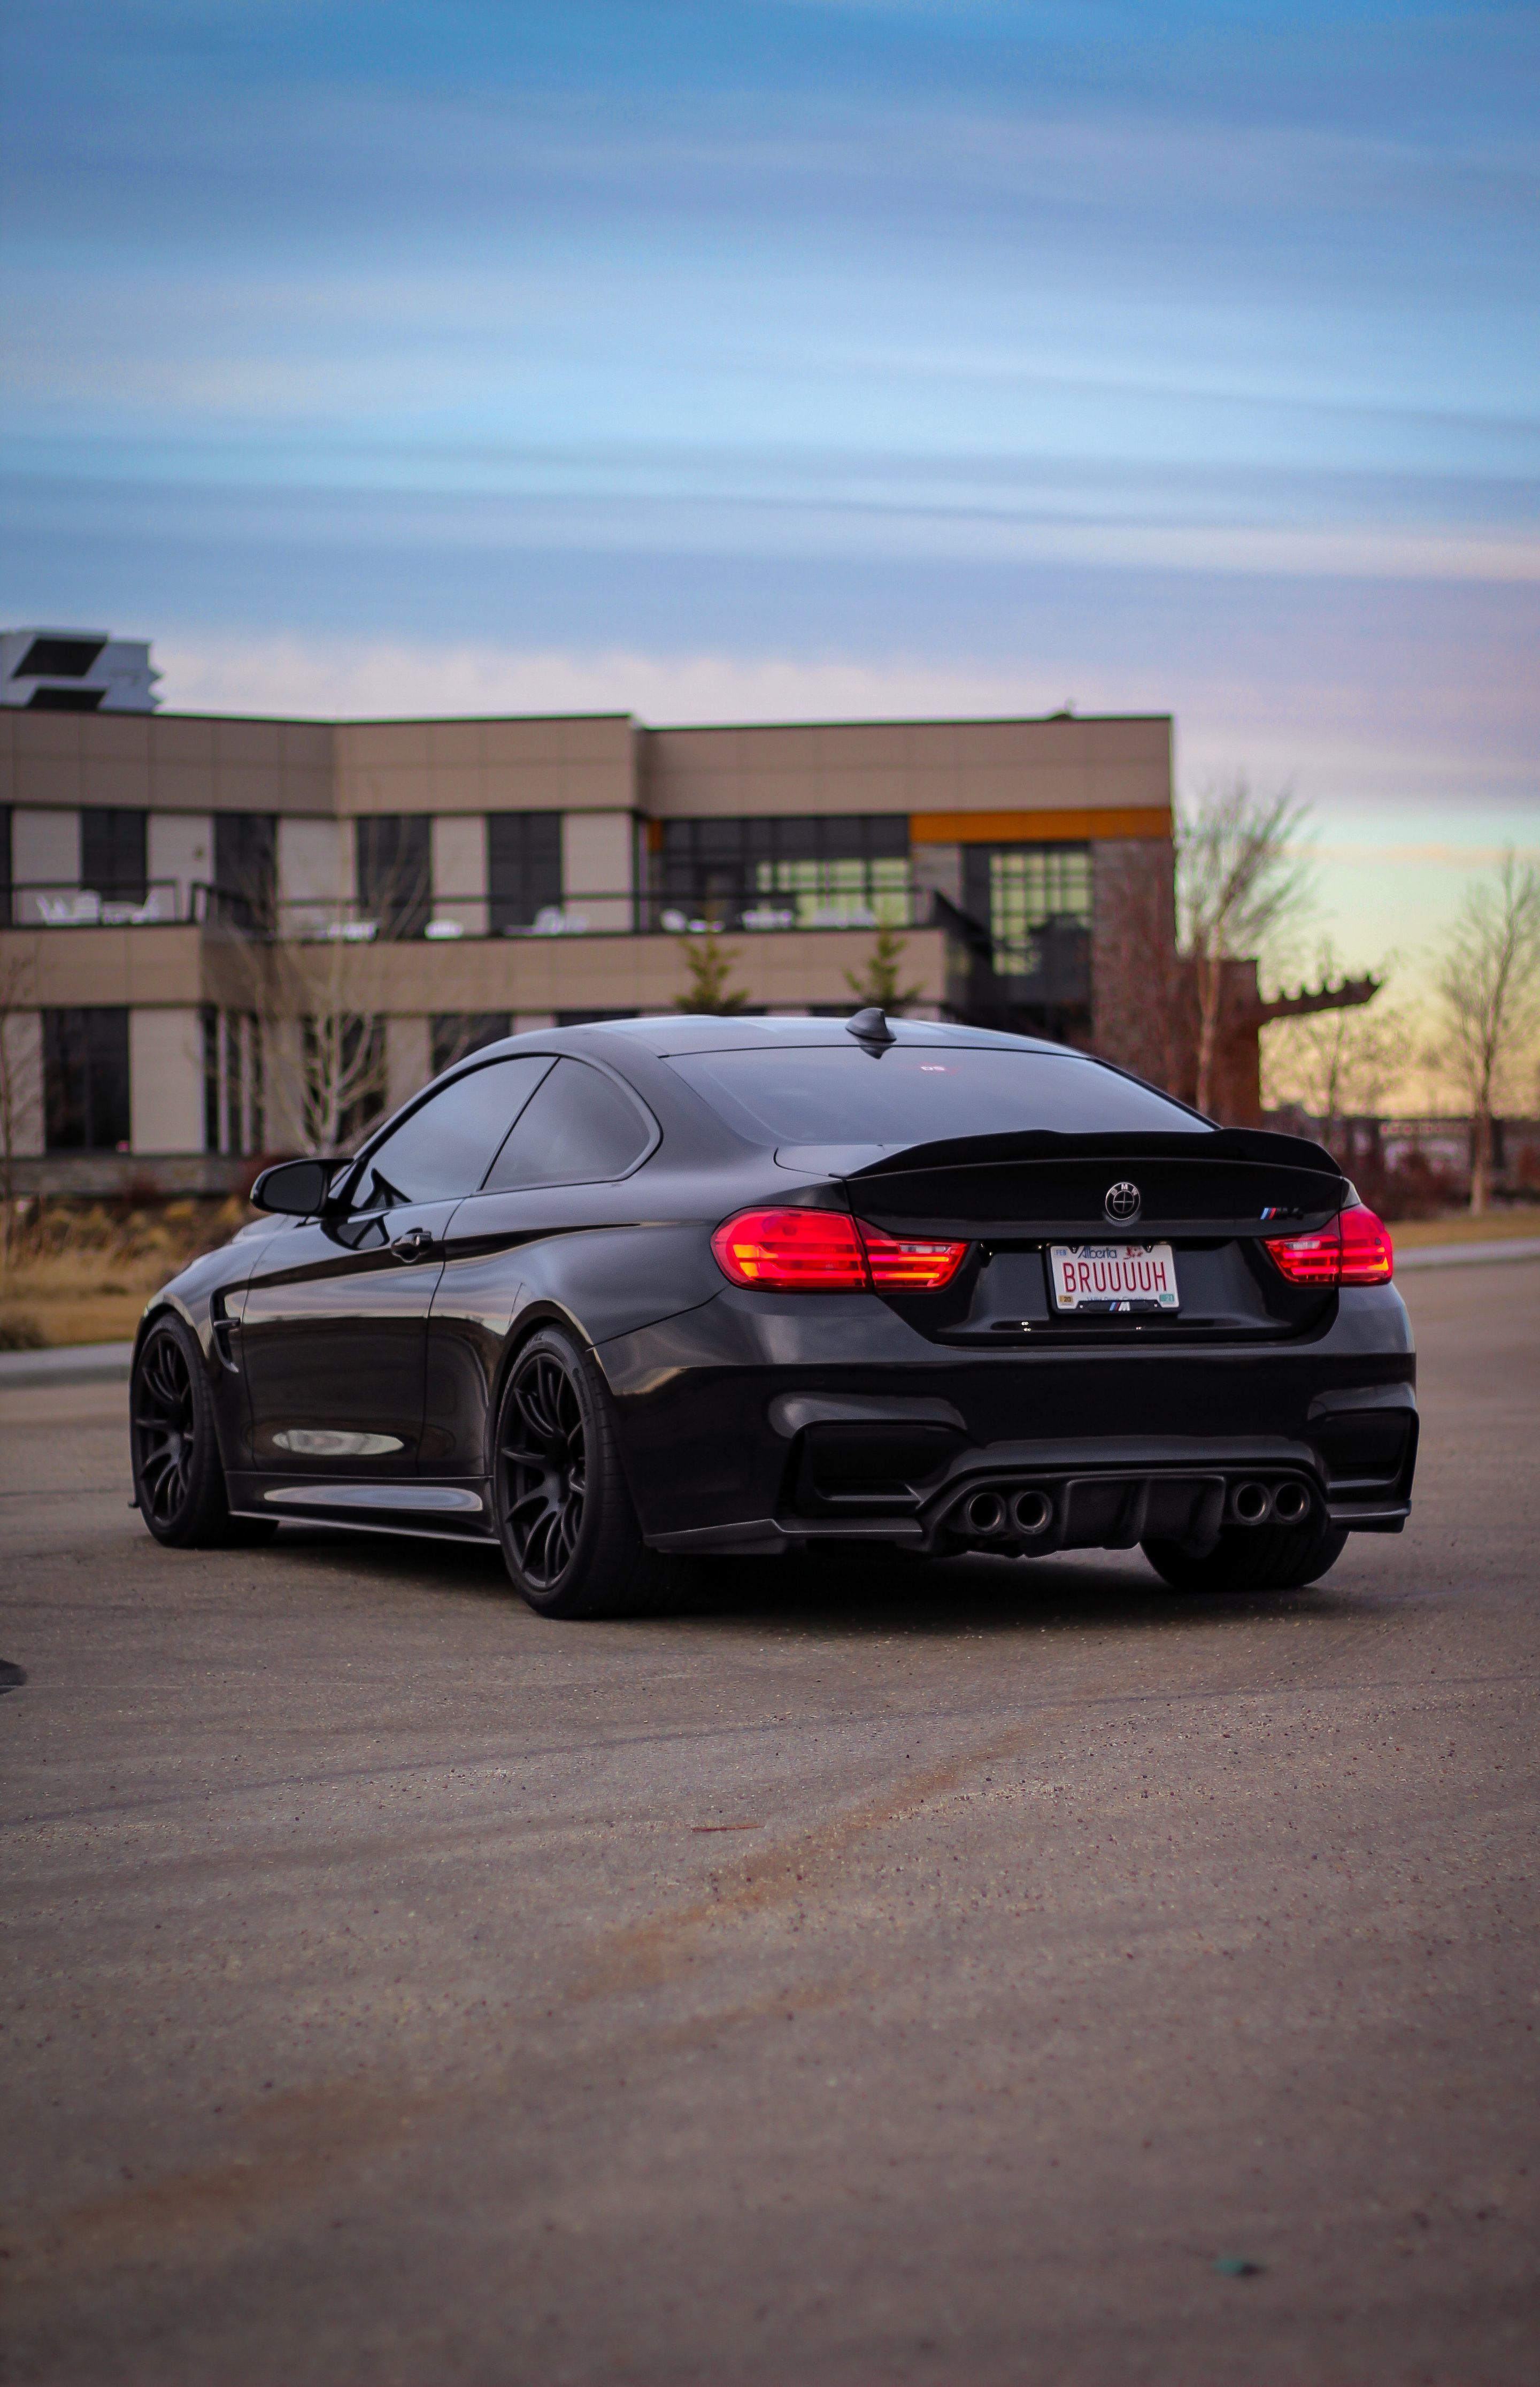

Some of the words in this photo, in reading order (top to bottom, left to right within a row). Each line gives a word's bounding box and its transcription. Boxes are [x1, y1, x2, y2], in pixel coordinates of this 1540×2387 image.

[1111, 1184, 1138, 1196] BMW
[1078, 1246, 1116, 1258] Alberta
[1062, 1261, 1167, 1292] BRUUUUH
